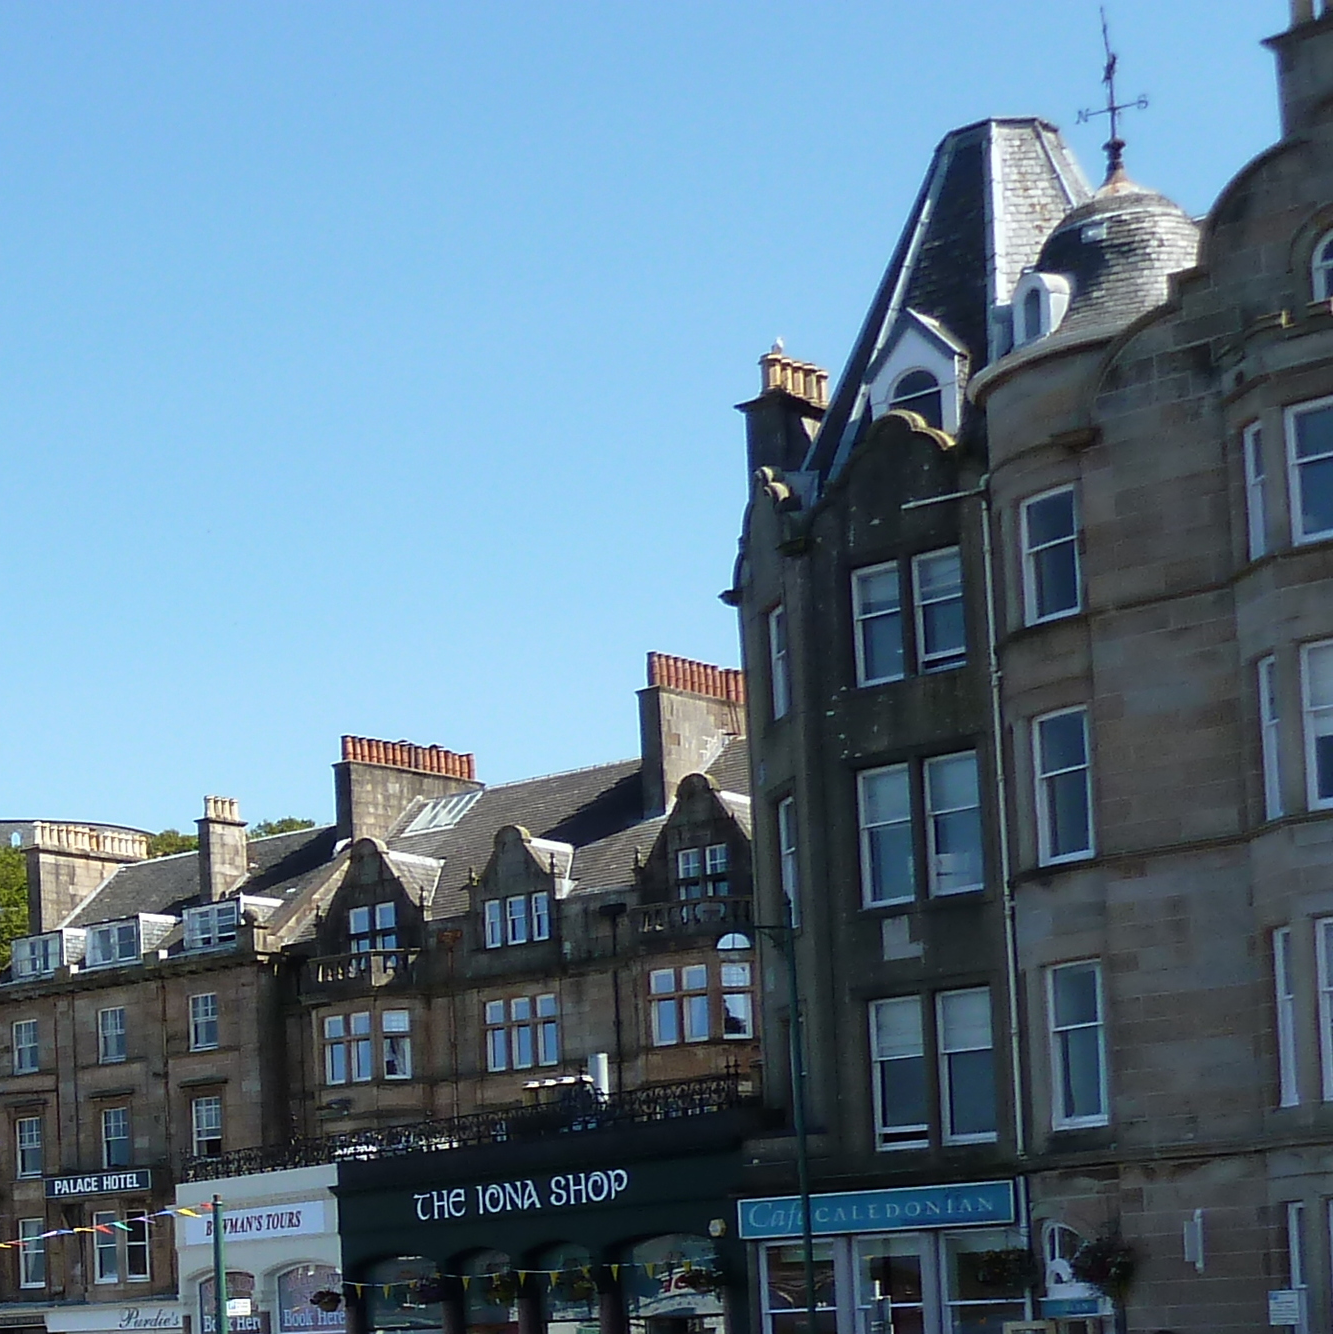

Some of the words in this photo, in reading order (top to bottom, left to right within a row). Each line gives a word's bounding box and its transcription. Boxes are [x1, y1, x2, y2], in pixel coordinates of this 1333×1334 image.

[54, 1177, 98, 1195] PALACE
[103, 1173, 140, 1190] HOTEL
[413, 1188, 466, 1220] THE
[476, 1180, 542, 1214] IONA
[550, 1169, 628, 1205] SHOP
[815, 1197, 994, 1223] CALEDONIAN
[206, 1215, 263, 1237] BWMAN'S
[266, 1211, 302, 1229] TOURS
[118, 1306, 180, 1330] Purdie's
[284, 1309, 314, 1327] Book
[317, 1308, 346, 1326] Here
